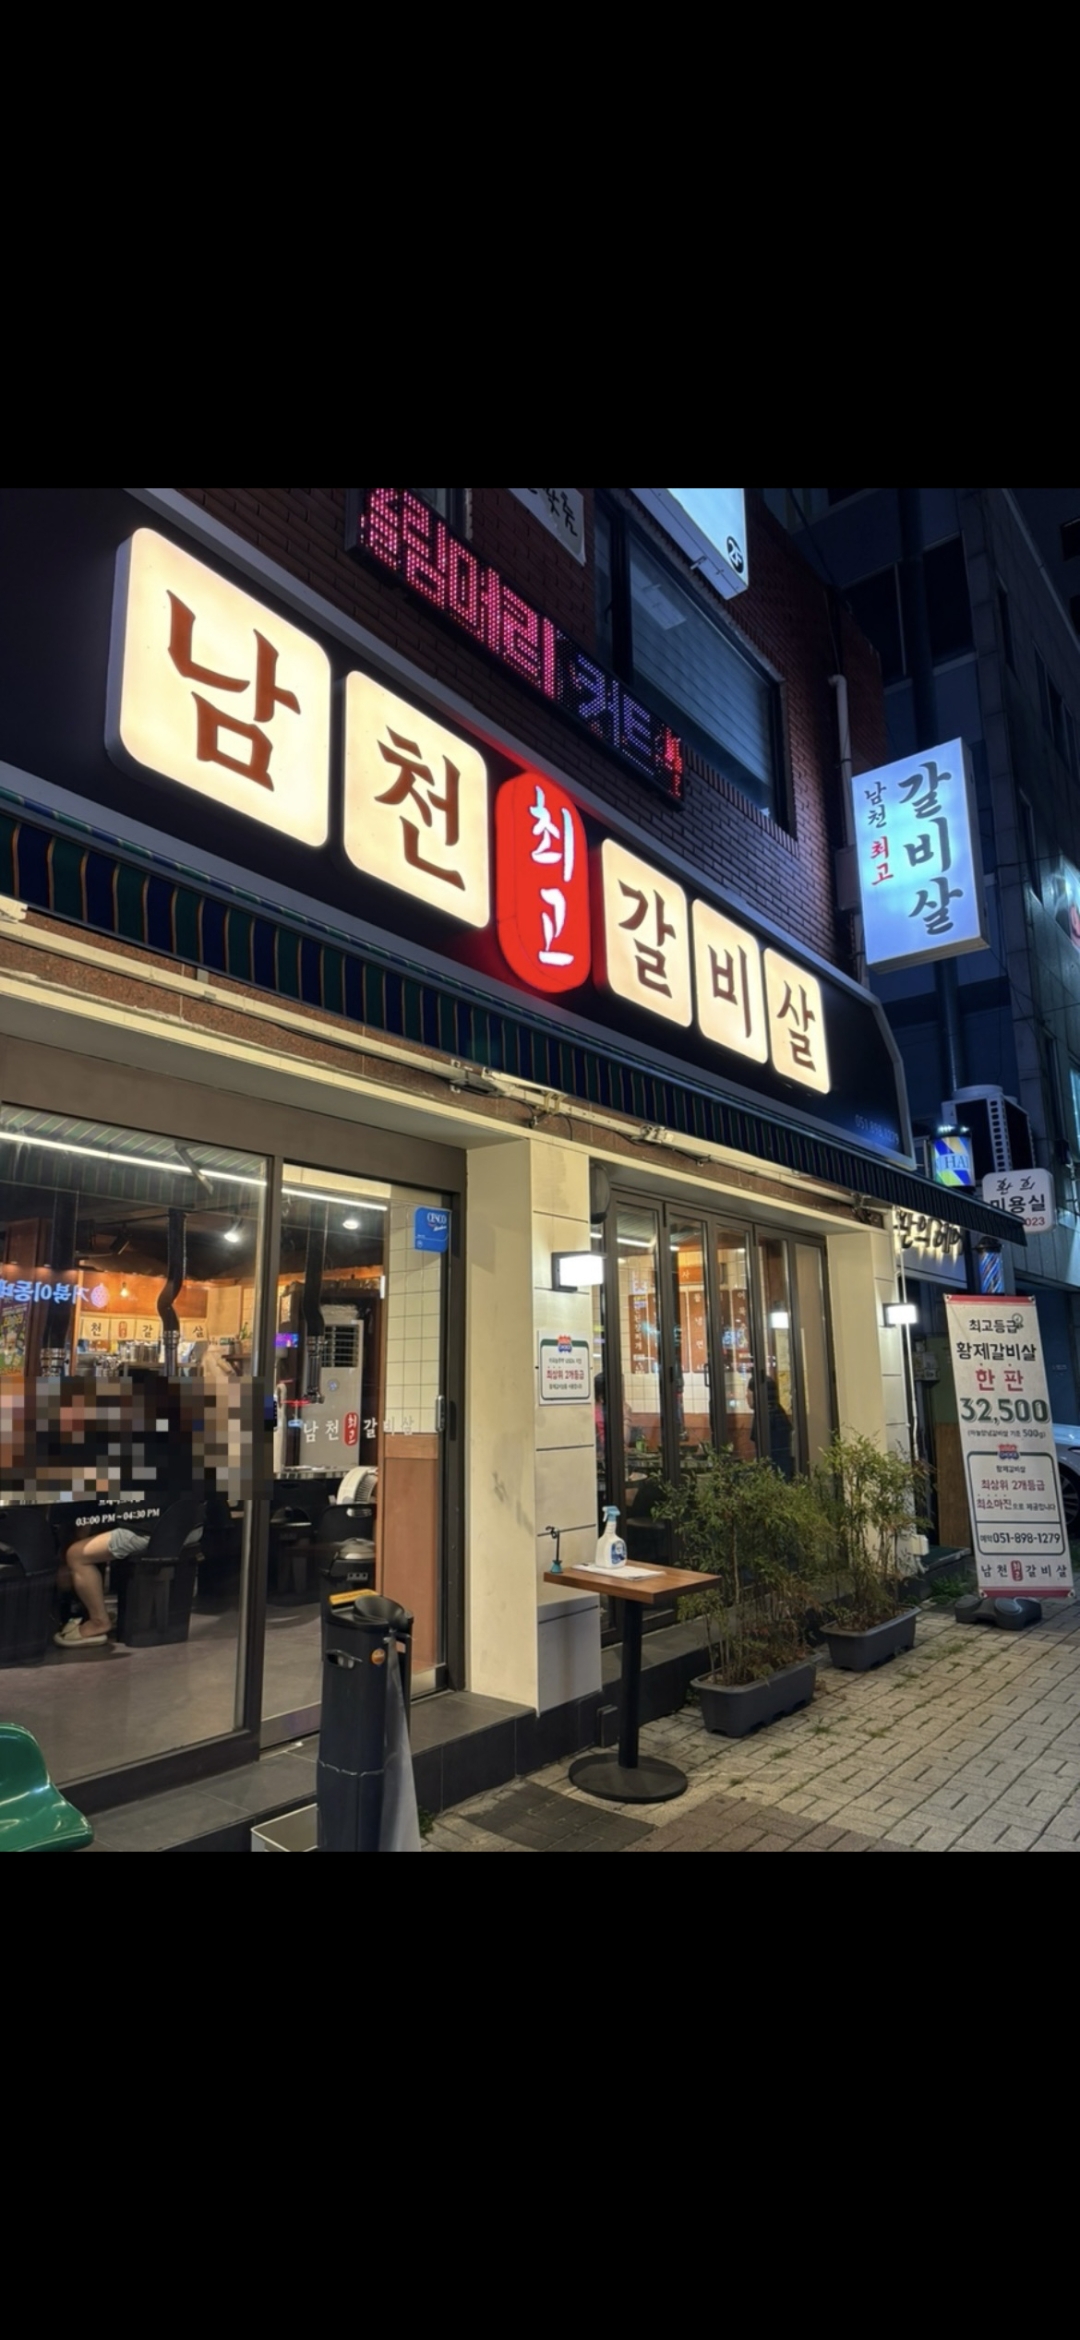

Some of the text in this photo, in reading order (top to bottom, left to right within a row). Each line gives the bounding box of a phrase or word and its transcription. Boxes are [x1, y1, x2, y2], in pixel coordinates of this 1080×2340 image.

[165, 588, 817, 1073] 남천 최고 갈비살
[864, 781, 894, 886] 남천 최고
[898, 761, 963, 936] 갈비살
[990, 1193, 1046, 1214] 미용실
[1022, 1216, 1046, 1227] 023
[969, 1319, 1020, 1334] 최고등급
[956, 1341, 1037, 1361] 황제갈비살
[975, 1369, 1024, 1392] 한 판
[960, 1398, 1050, 1425] 32,500
[981, 1480, 1045, 1491] 최상위 2개등급
[75, 1515, 100, 1526] 03:00
[101, 1513, 115, 1523] PM
[123, 1509, 146, 1520] 04:30
[147, 1508, 160, 1517] PM
